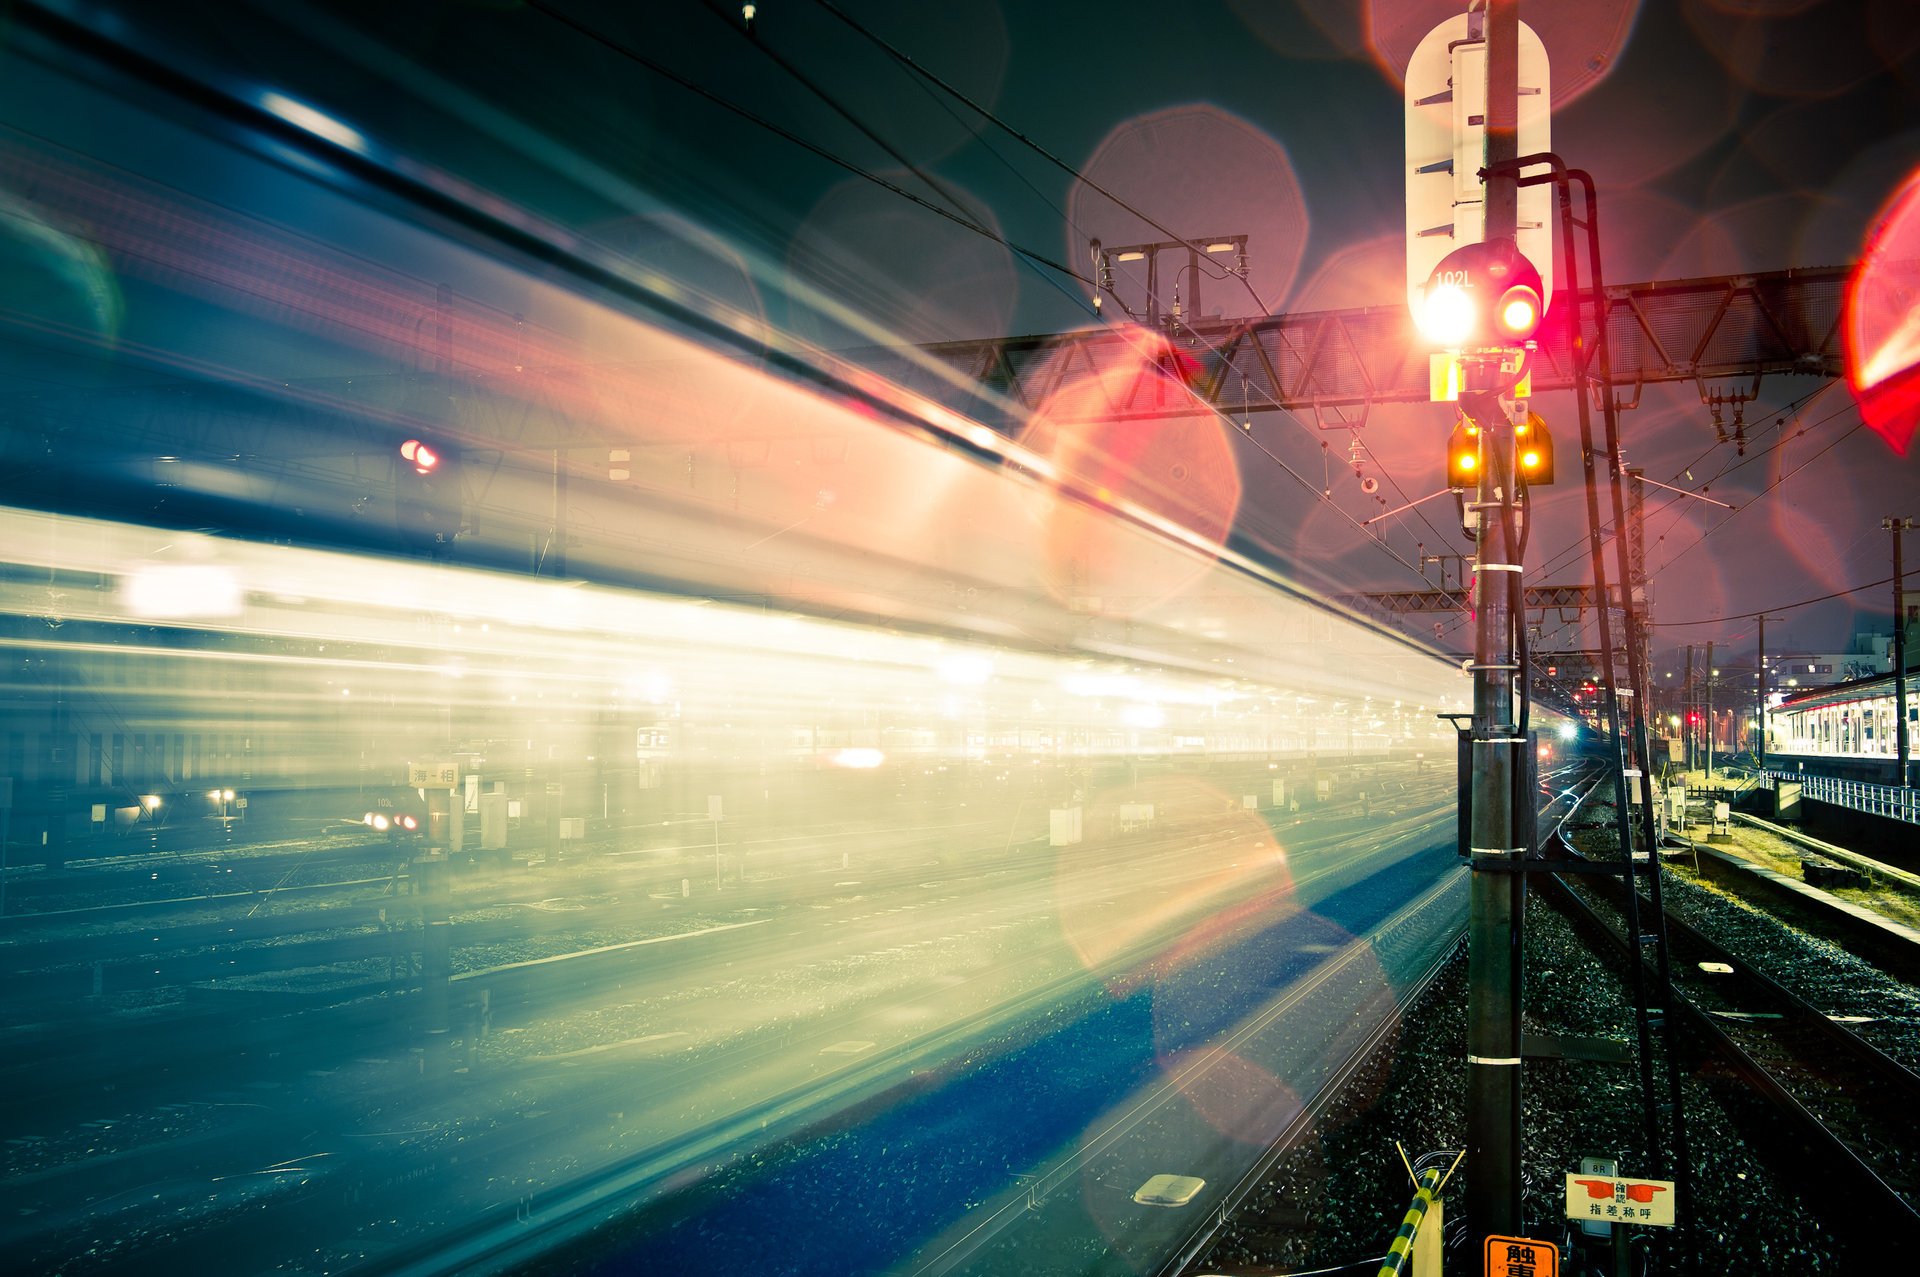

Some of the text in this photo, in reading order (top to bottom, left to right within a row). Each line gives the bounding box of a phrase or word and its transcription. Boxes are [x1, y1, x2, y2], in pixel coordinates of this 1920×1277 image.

[1435, 270, 1475, 288] 102L
[435, 532, 447, 543] 3L
[1592, 1164, 1606, 1174] 8R
[1615, 1183, 1626, 1204] 確認
[1590, 1203, 1652, 1220] 指差称呼
